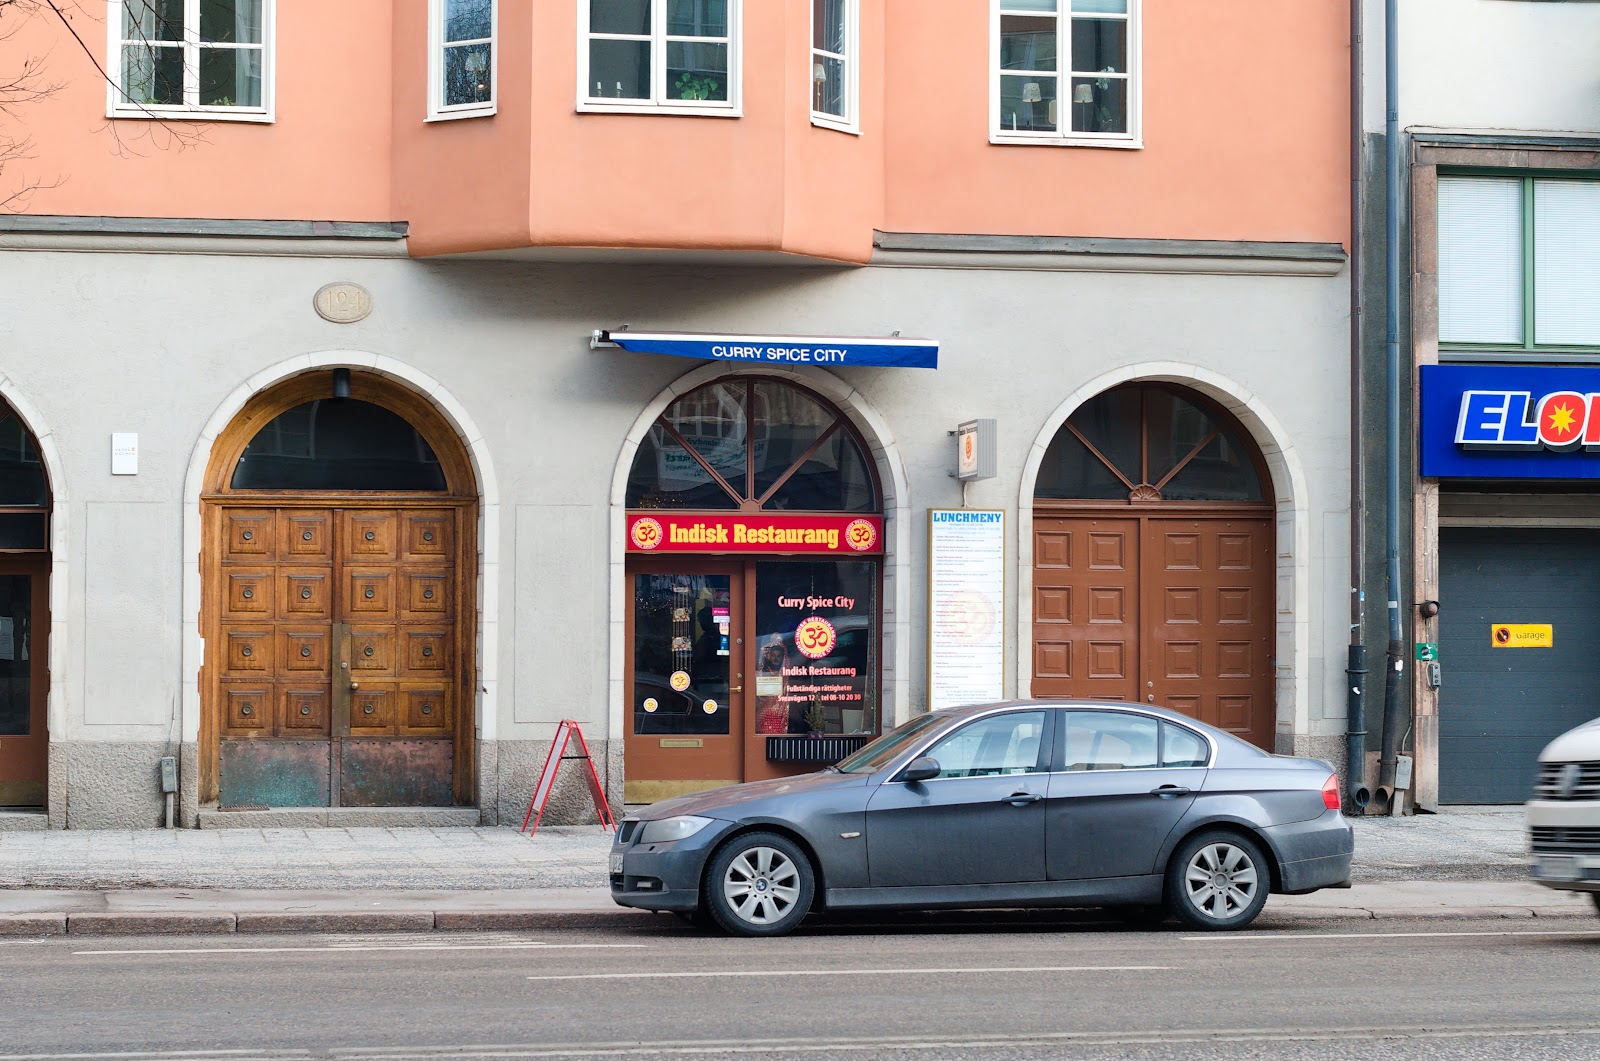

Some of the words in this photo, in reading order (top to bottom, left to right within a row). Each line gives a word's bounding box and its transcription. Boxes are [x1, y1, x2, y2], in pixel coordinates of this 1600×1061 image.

[712, 345, 763, 359] CURRY
[766, 347, 811, 361] SPICE
[814, 349, 847, 362] CITY
[933, 512, 1001, 523] LUNCHMENY
[669, 523, 728, 543] Indisk
[733, 524, 839, 549] Restaurang
[778, 596, 805, 610] Curry
[806, 595, 833, 610] Spice
[834, 595, 855, 610] City
[782, 666, 807, 676] Indisk
[808, 666, 857, 677] Restaurang
[786, 685, 820, 693] Fullständiga
[821, 684, 853, 693] rättigheter
[778, 695, 808, 703] Sveavägen
